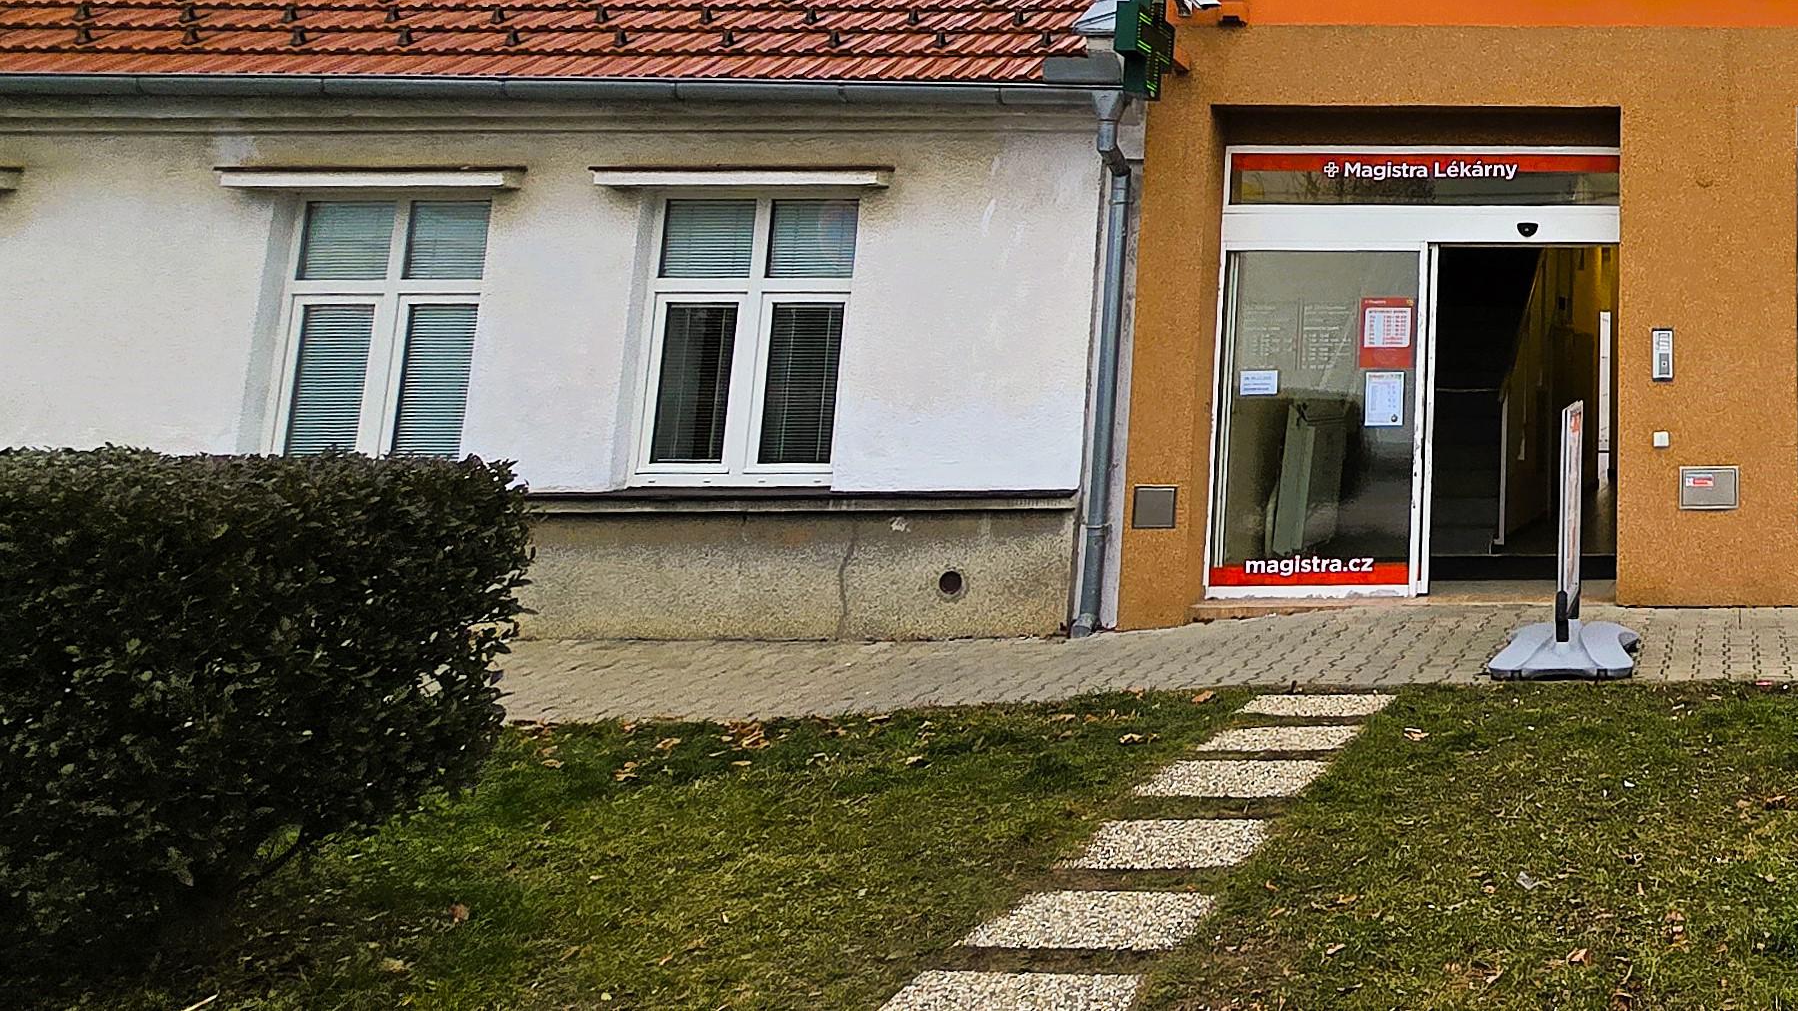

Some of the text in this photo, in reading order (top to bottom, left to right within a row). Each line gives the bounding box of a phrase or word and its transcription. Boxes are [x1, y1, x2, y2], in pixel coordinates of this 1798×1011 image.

[1343, 160, 1517, 180] Magistra Lékárny
[1245, 556, 1374, 576] magistra.cz
